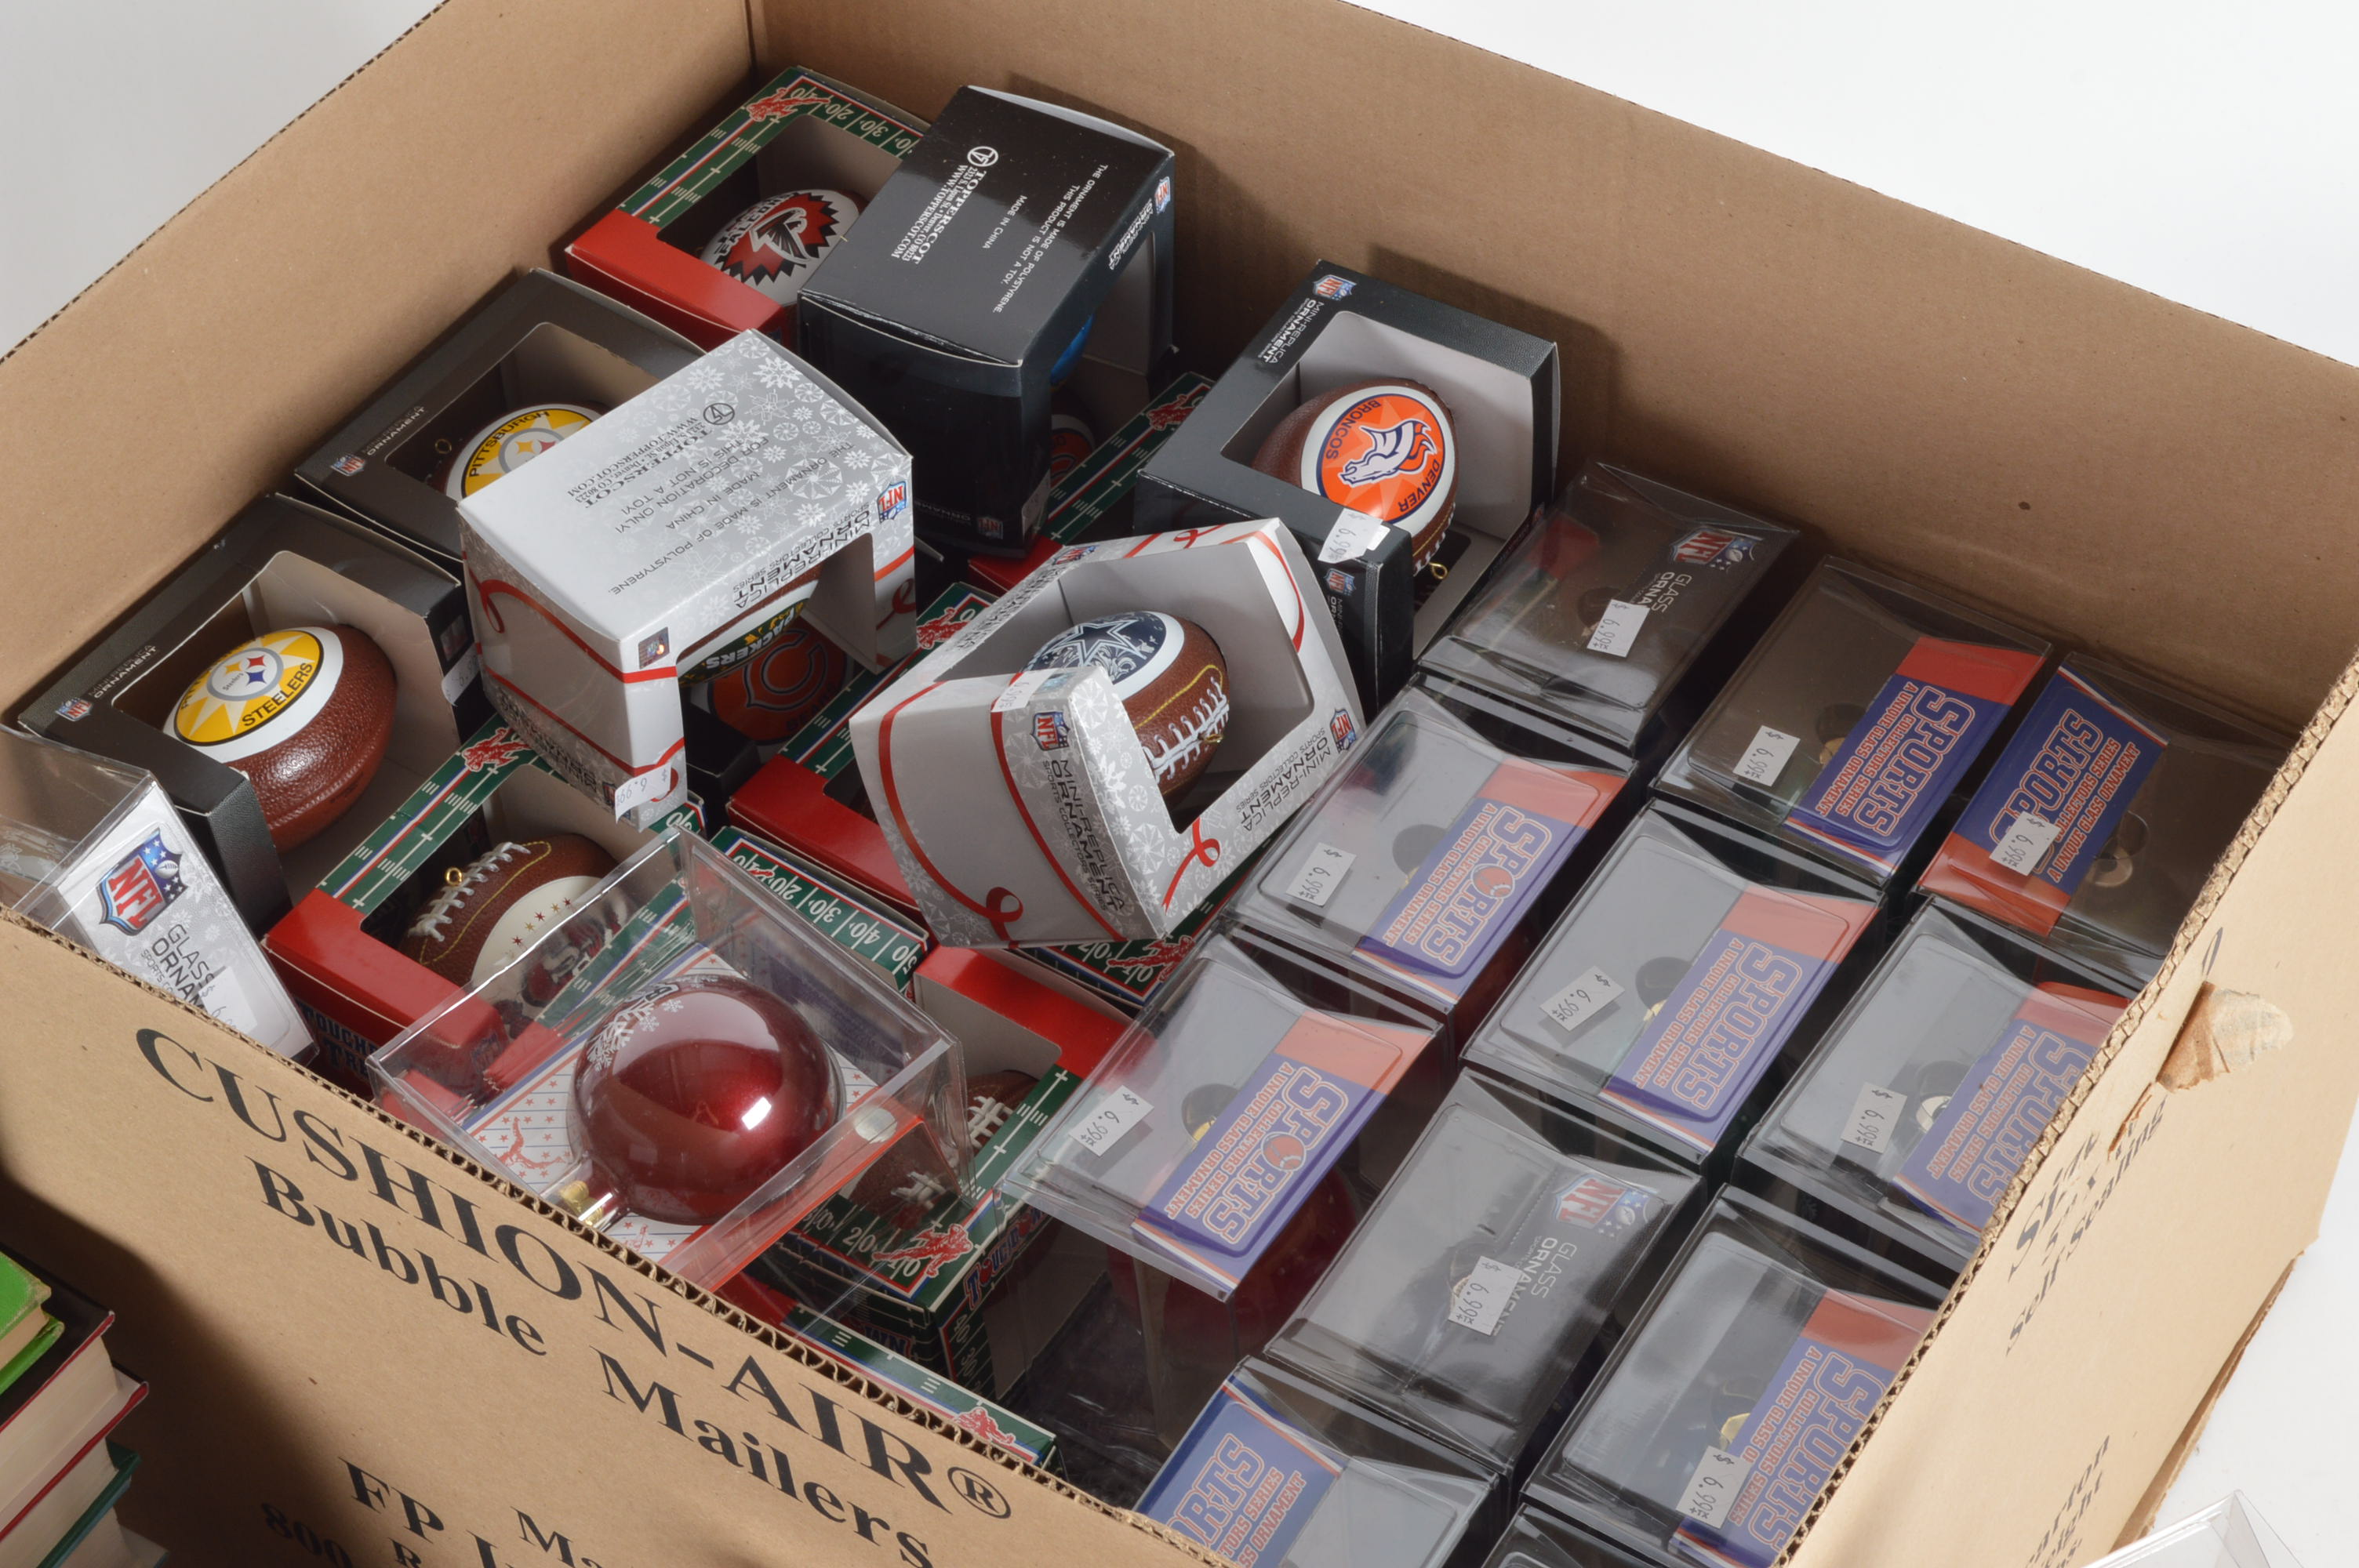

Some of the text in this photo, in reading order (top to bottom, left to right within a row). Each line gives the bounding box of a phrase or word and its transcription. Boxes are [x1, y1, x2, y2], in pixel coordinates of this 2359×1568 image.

[891, 165, 968, 258] WWW.TOPPERSCOT.COM
[914, 170, 987, 264] TOPPERSCOT
[980, 193, 1028, 250] MADE IN CHINA
[990, 163, 1107, 315] THE ORNAMENT IS MADE OF POLYSTYRENE.
[999, 182, 1080, 287] THIS PRODUCT IS NOT A TOY.
[1263, 299, 1316, 362] ORNAMENT
[1269, 302, 1325, 363] MINI-REPLICA
[367, 406, 426, 456] ORNAMENT
[470, 412, 551, 477] PITTSBURGH
[585, 430, 713, 508] TOPPERSCOT
[653, 440, 744, 495] THIS IS NOT A
[1326, 398, 1381, 459] BRONCOS
[656, 437, 769, 507] FOR DECORATION
[666, 471, 761, 530] MADE IN CHINA
[878, 485, 904, 511] NFL
[1398, 459, 1441, 514] DENVER
[608, 442, 854, 595] THE ORNAMENT IS MADE OF POLYSTYRENE.
[734, 510, 870, 600] ORNAMENT
[1677, 532, 1732, 564] NFL
[736, 520, 870, 608] MINI-REPLICA
[1652, 574, 1692, 613] GLASS
[94, 646, 157, 699] ORNAMENT
[707, 608, 794, 669] PACKERS
[242, 662, 313, 727] STEELERS
[1038, 717, 1059, 749] NFL
[1332, 714, 1351, 739] NFL
[1236, 728, 1325, 812] SPORTS COLLECTORS SERIES
[1241, 737, 1329, 824] ORNAMENT
[1244, 746, 1331, 831] MINI-REPLICA
[1815, 681, 1919, 816] A UNIQUE GLASS ORNAMENT
[1836, 715, 1916, 816] COLLECTORS SERIES
[1853, 685, 1976, 837] SPORTS
[2091, 738, 2121, 778] SERIES
[1042, 761, 1062, 804] SPORTS
[1060, 808, 1089, 873] COLLECTORS
[1052, 760, 1118, 911] ORNAMENT
[1060, 760, 1125, 910] MINI-REPLICA
[2046, 742, 2141, 883] A UNIQUE GLASS ORNAMENT
[109, 858, 163, 929] NFL
[1383, 804, 1499, 947] A UNIQUE GLASS ORNAMENT
[1403, 835, 1492, 946] COLLECTORS SERIES
[141, 949, 165, 983] SPORTS
[1632, 938, 1745, 1091] A UNIQUE GLASS ORNAMENT
[1653, 974, 1739, 1089] COLLECTORS SERIES
[1671, 942, 1803, 1111] SPORTS
[1164, 1062, 1297, 1220] A UNIQUE GLASS ORNAMENT
[1926, 1025, 2037, 1180] A UNIQUE GLASS ORNAMENT
[1948, 1063, 2034, 1183] COLLECTORS SERIES
[1186, 1099, 1286, 1219] COLLECTORS SERIES
[1559, 1178, 1627, 1225] NFL
[1531, 1243, 1578, 1298] GLASS
[245, 1155, 933, 1568] Bubble Mailers
[1750, 1346, 1823, 1451] A UNIQUE GLASS
[338, 1456, 445, 1544] FP
[1243, 1467, 1285, 1521] SERIES
[1728, 1388, 1819, 1526] COLLECTORS SERIES
[1250, 1470, 1307, 1552] ORNAMENT
